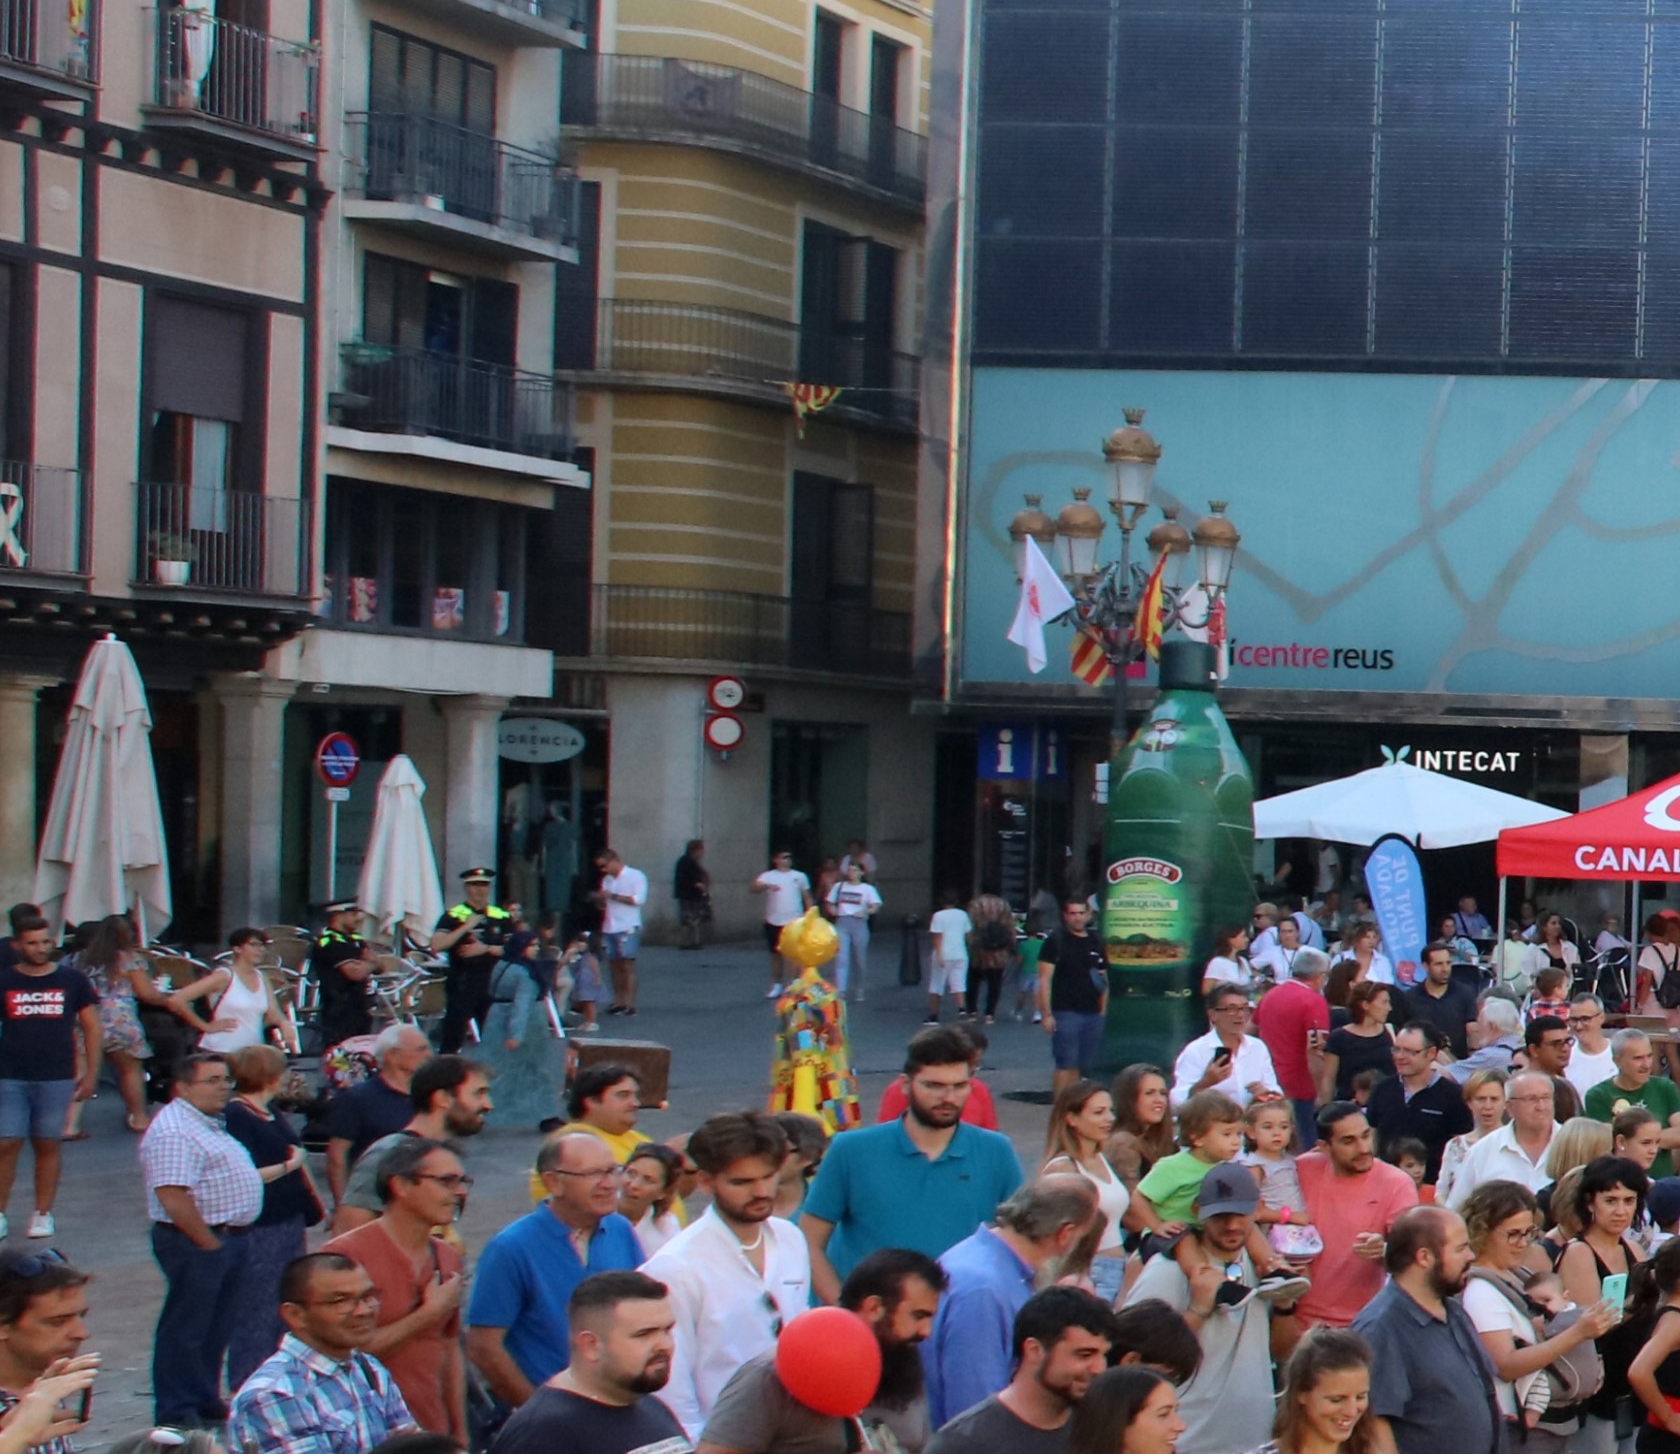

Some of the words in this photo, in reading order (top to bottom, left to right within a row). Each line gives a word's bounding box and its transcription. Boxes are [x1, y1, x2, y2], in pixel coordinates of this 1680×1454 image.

[1333, 647, 1395, 670] reus
[498, 735, 580, 747] LORENCIA
[1415, 750, 1520, 772] INTECAT
[1115, 861, 1172, 878] BORGES
[12, 992, 65, 1003] JACK&
[14, 1004, 65, 1015] JONES
